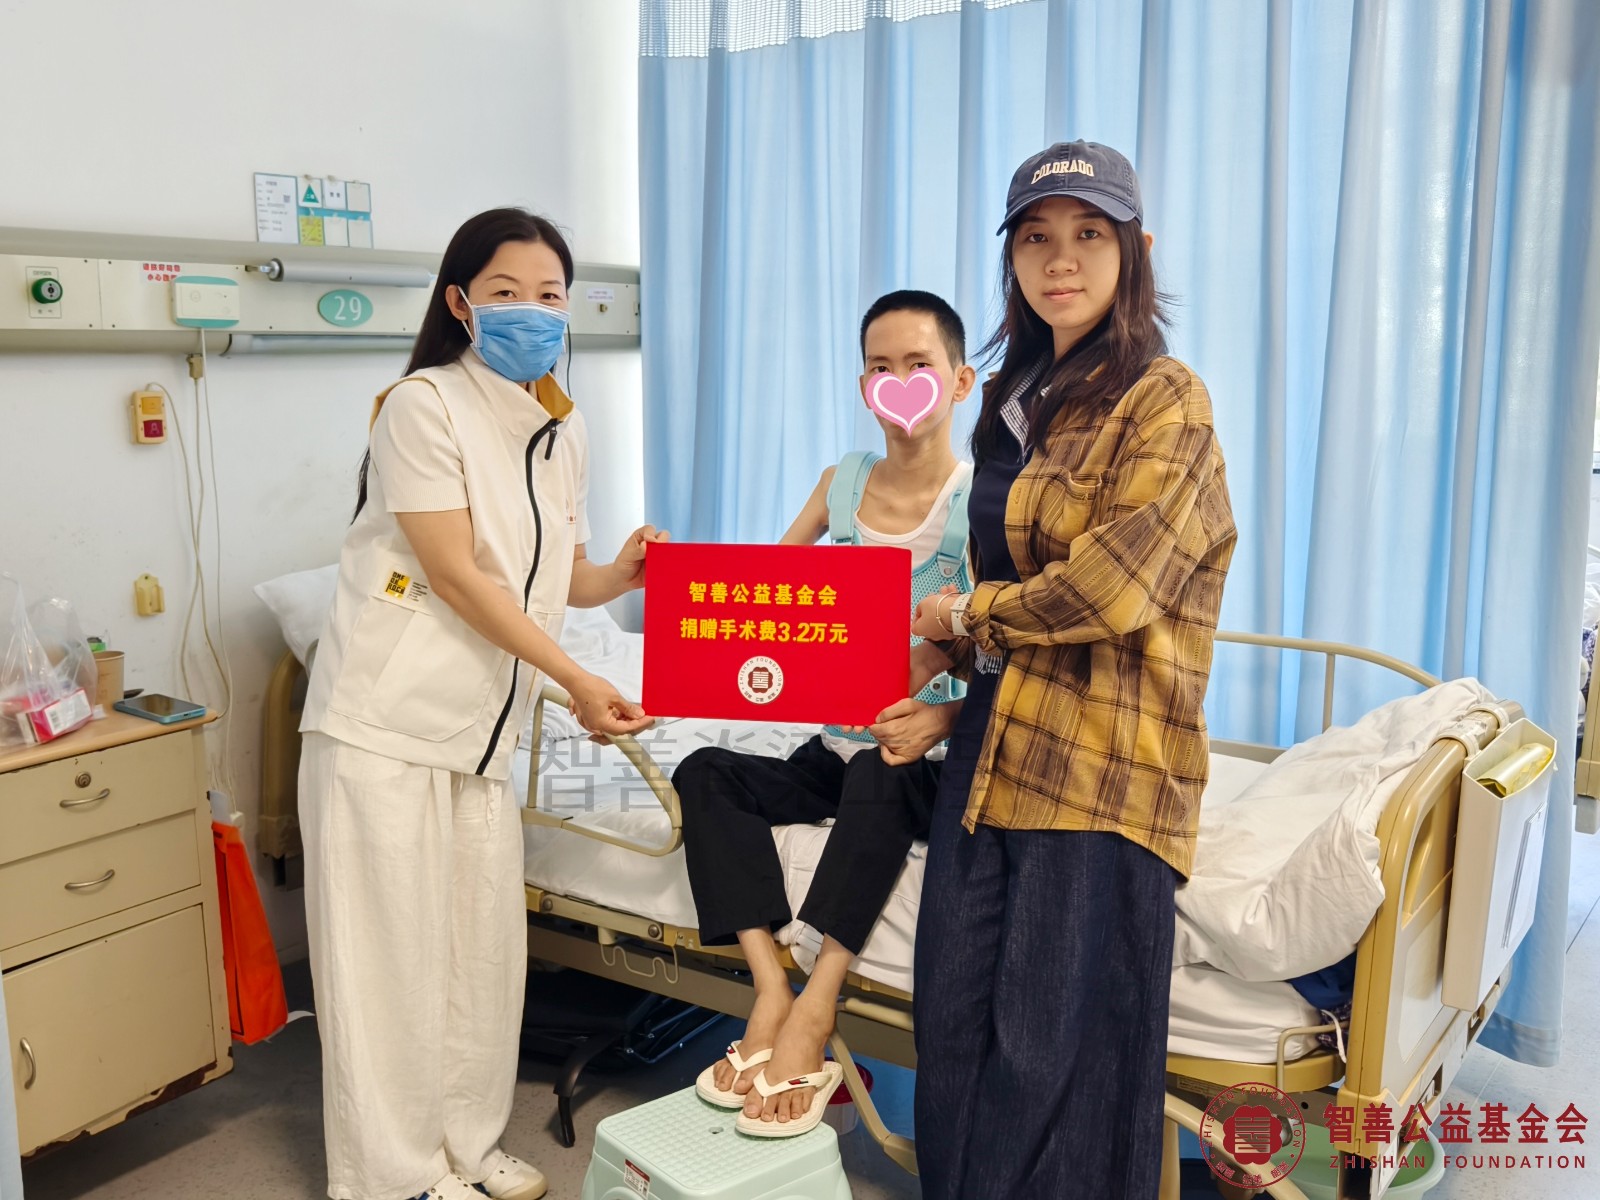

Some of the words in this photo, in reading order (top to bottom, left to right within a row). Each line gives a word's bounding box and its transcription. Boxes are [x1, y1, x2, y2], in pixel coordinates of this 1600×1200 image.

[1030, 159, 1095, 185] COLORADO
[334, 295, 362, 321] 29
[689, 581, 837, 606] 智善公益基金会
[680, 617, 848, 644] 捐赠手术费3.2万元
